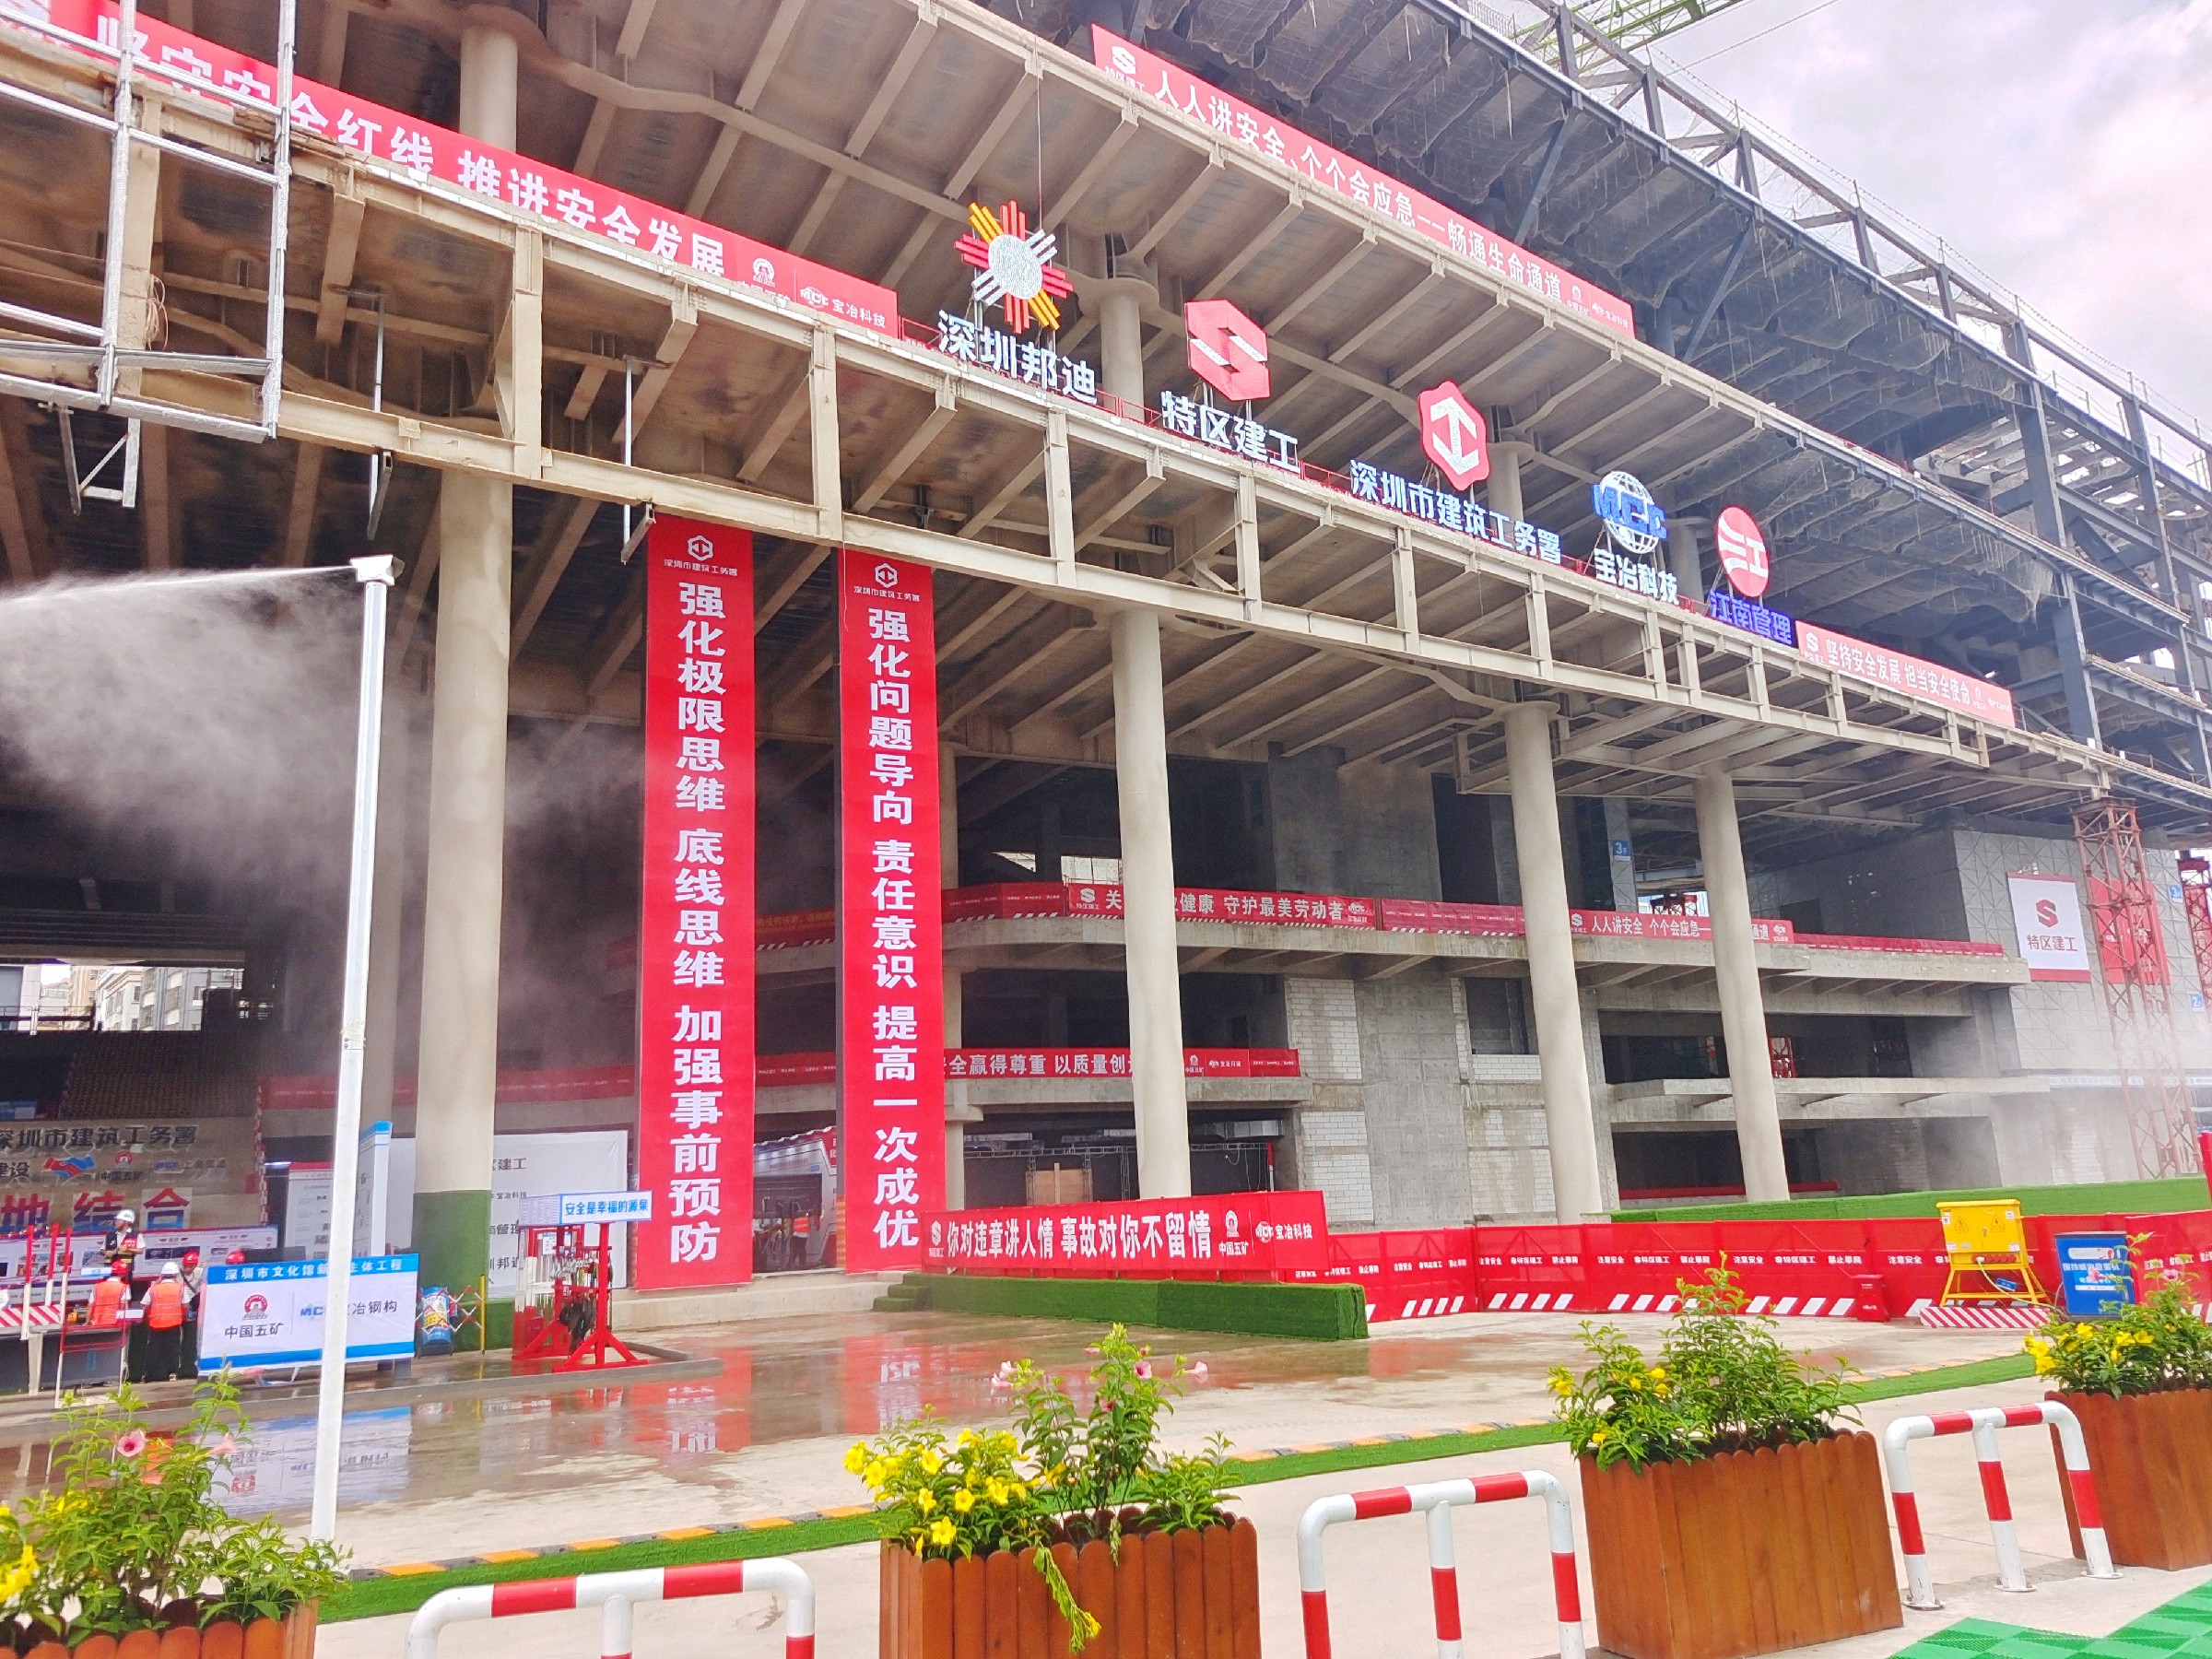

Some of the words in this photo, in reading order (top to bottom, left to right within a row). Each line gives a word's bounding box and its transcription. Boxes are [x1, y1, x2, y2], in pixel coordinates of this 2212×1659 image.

[458, 150, 724, 277] 推进安全发展
[832, 300, 886, 329] 宝冶科技
[938, 309, 1097, 405] 深圳邦迪
[1160, 391, 1300, 474] 特区建工
[1350, 459, 1561, 564] 深圳市建筑工务署
[664, 559, 738, 576] 深圳市建筑工务署
[1594, 547, 1679, 605] 宝冶科技
[853, 585, 920, 602] 深圳市建筑工务署
[1710, 590, 1792, 644] 江南管理
[675, 582, 726, 812] 强化极限思维
[1826, 638, 1901, 685] 坚持安全发展
[1904, 662, 1971, 706] 担当安全使命
[867, 607, 914, 825] 强化问题导向
[673, 828, 725, 988] 底线思维
[871, 839, 918, 989] 责任意识
[1224, 895, 1344, 921] 守护最美劳动者
[1592, 916, 1643, 935] 人人讲安全
[2027, 935, 2077, 952] 特区建工
[944, 1053, 1046, 1076] 全赢得尊重
[1054, 1053, 1135, 1076] 以质量创
[668, 1005, 724, 1264] 加强事前预防
[872, 1005, 920, 1249] 提高一次成优
[565, 1198, 649, 1217] 安全是幸福的源泉
[1276, 1223, 1312, 1241] 宝冶科技
[947, 1218, 1053, 1259] 你对违章讲人情
[1060, 1209, 1212, 1260] 事故对你不留情
[1218, 1241, 1249, 1257] 中国五矿
[225, 1322, 284, 1339] 中国五矿
[300, 1306, 324, 1316] MC
[347, 1300, 397, 1315] 冶钢构
